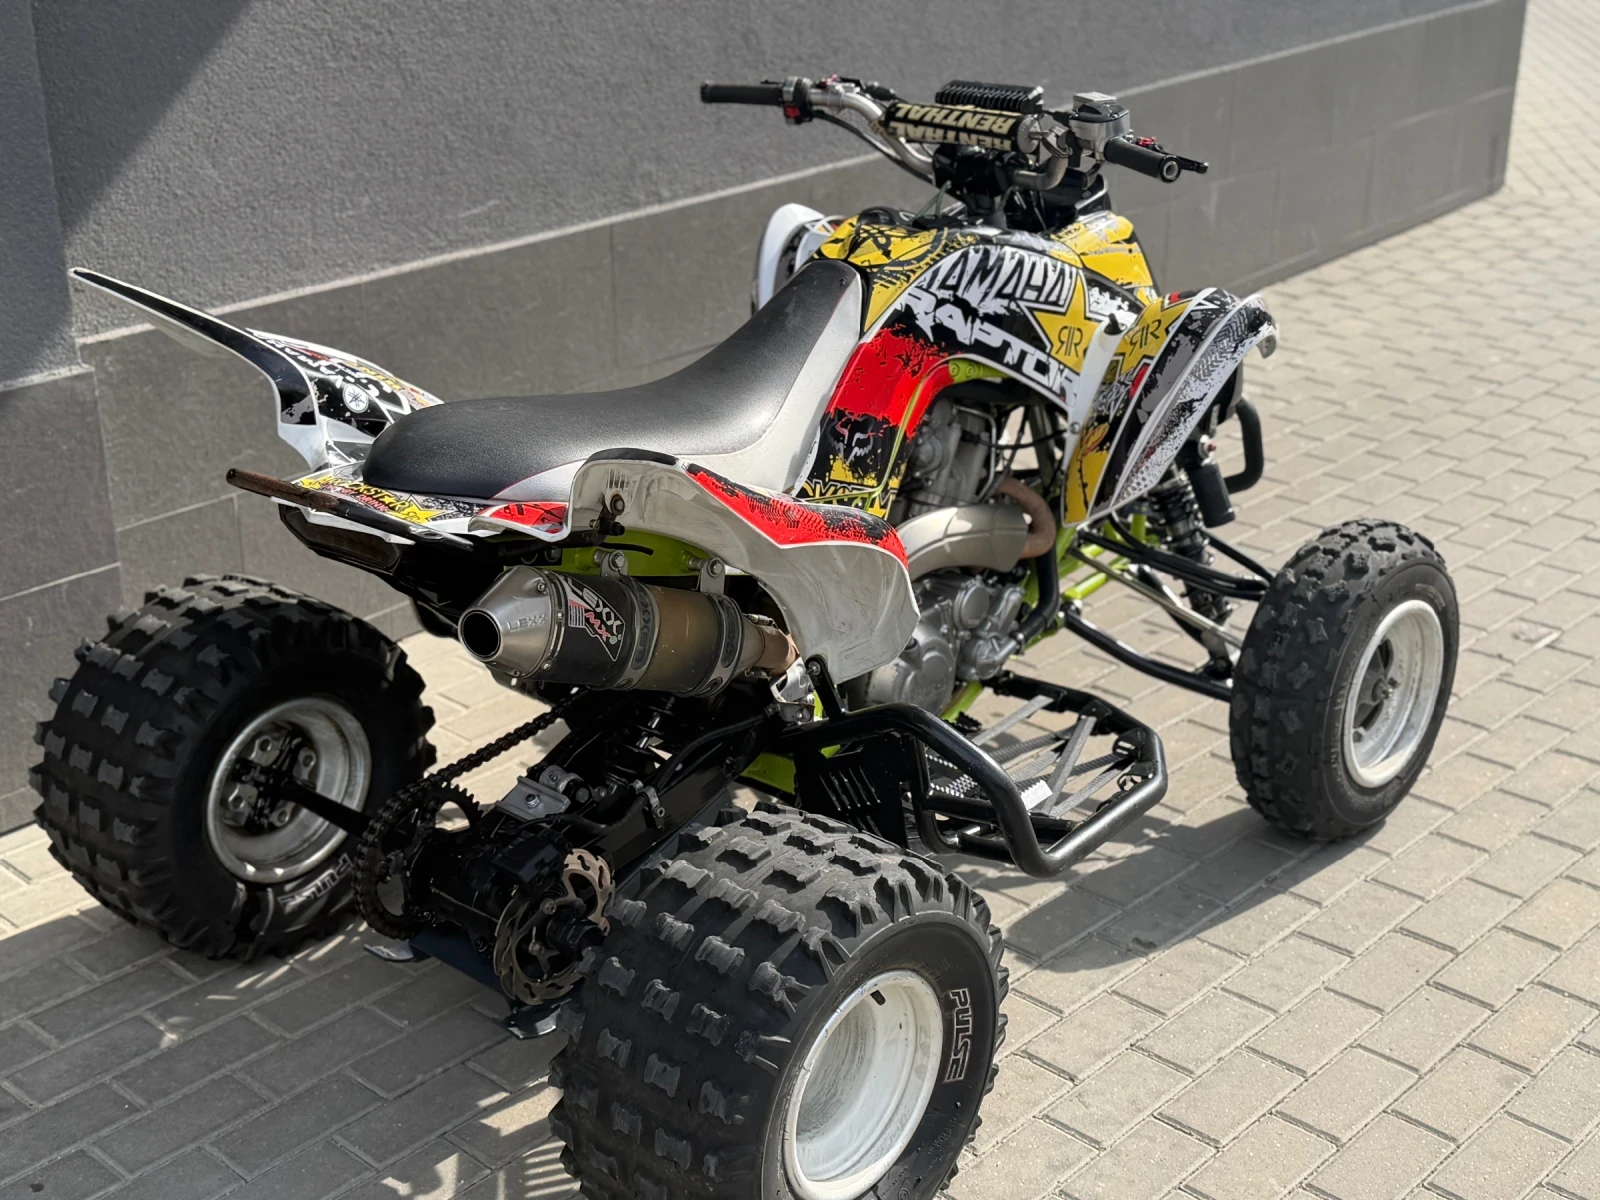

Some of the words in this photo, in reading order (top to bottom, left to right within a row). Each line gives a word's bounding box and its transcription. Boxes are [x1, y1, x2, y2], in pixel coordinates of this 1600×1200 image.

[895, 103, 1016, 135] RENTHAL
[902, 287, 1079, 408] RAPTOR
[507, 614, 549, 633] LEXX
[567, 577, 623, 635] LEXX
[945, 987, 973, 1084] PULSE
